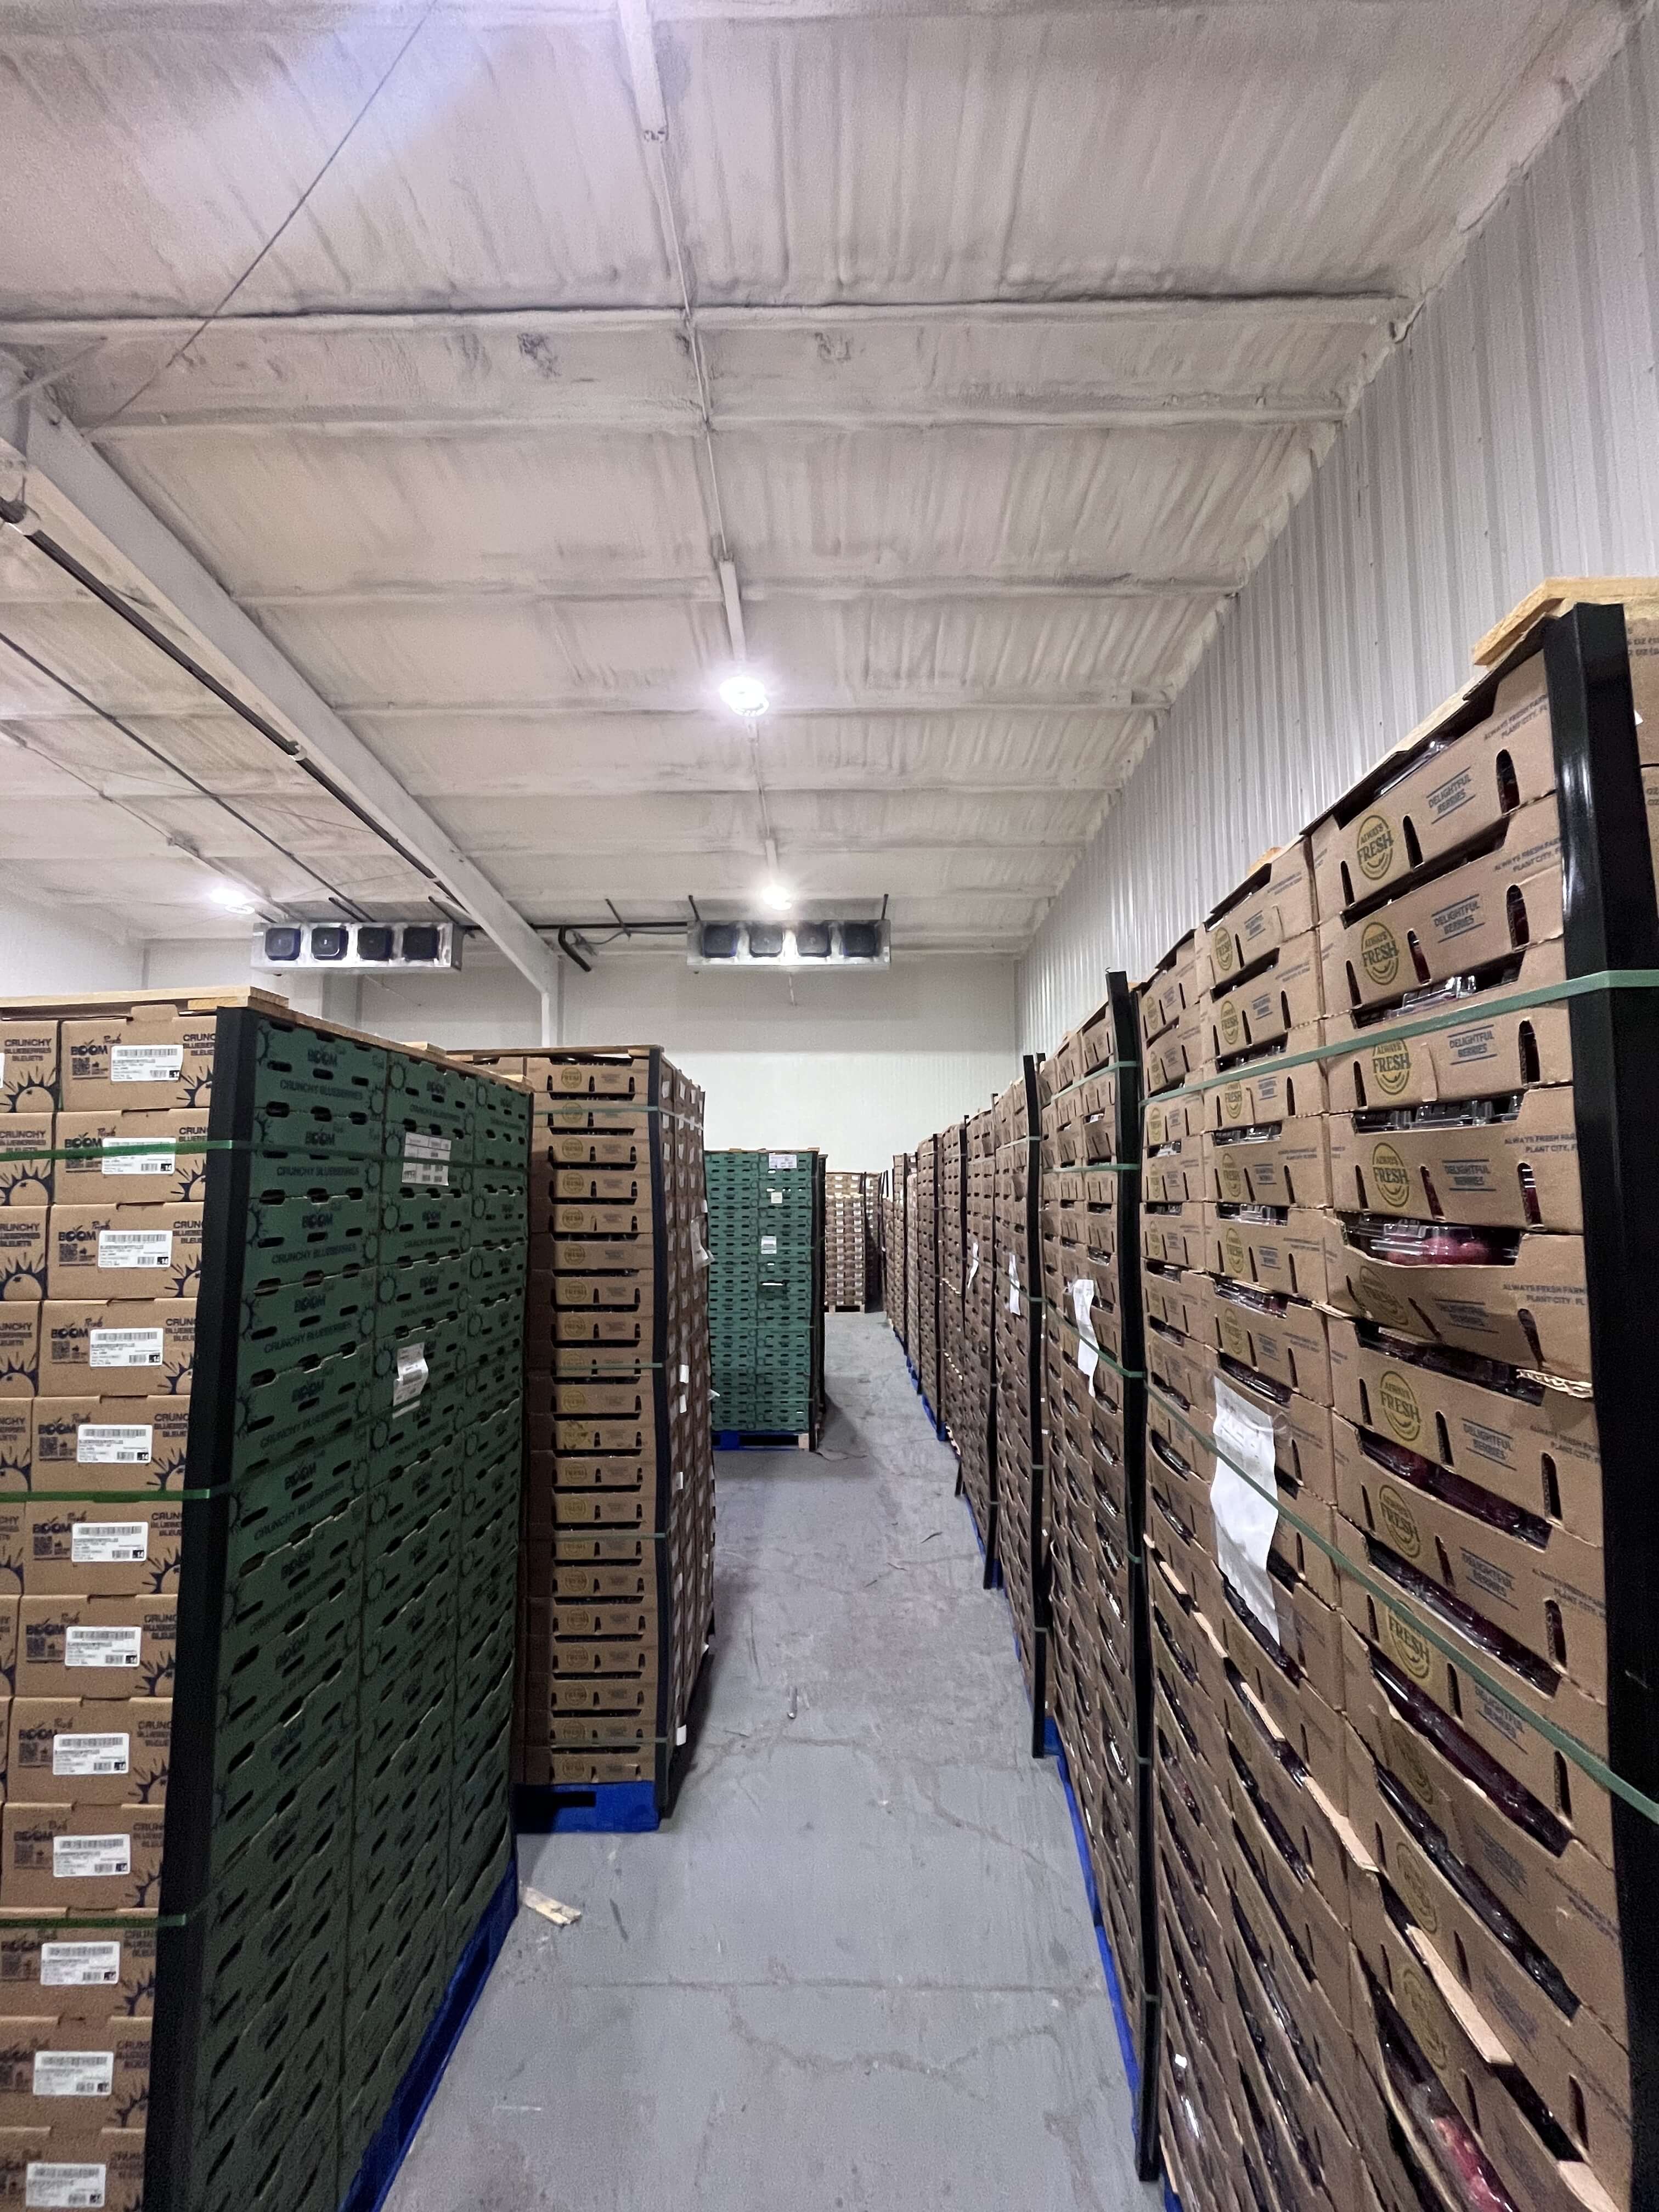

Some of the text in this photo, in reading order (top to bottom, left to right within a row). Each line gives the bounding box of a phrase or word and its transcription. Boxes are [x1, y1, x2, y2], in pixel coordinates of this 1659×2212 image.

[1428, 773, 1472, 809] DELIGHTFUL
[1437, 788, 1466, 815] BERRIES
[1361, 823, 1384, 844] ALWAYS
[1357, 831, 1394, 861] FRESH
[1513, 857, 1535, 871] PLANT
[1434, 901, 1480, 927] DELIGHTFUL
[1443, 915, 1474, 935] BERRIES
[1364, 931, 1388, 947] ALWAYS
[1362, 940, 1399, 967] FRESH
[5, 1039, 52, 1047] CRUNCHY
[1449, 1031, 1495, 1049] DELIGHTFUL
[71, 1045, 108, 1056] BOOM
[1375, 1041, 1402, 1057] ALWAYS
[1458, 1043, 1488, 1058] BERRIES
[1373, 1052, 1411, 1074] FRESH
[280, 1079, 318, 1093] CRUNCHY
[65, 1139, 103, 1148] BOOM
[305, 1131, 335, 1146] BOOM
[1505, 1136, 1534, 1144] ALWAYS
[1525, 1145, 1549, 1153] PLANT
[277, 1167, 313, 1176] CRUNCHY
[1373, 1167, 1409, 1185] FRESH
[1444, 1164, 1491, 1175] DELIGHTFUL
[302, 1213, 333, 1228] BOOM
[59, 1231, 96, 1242] BOOM
[272, 1249, 311, 1265] CRUNCHY
[1526, 1294, 1552, 1302] PLANT
[52, 1328, 89, 1339] BOOM
[264, 1333, 305, 1353] CRUNCHY
[1384, 1380, 1410, 1400] ALWAYS
[1380, 1390, 1421, 1423] FRESH
[1463, 1423, 1513, 1451] DELIGHTFUL
[1472, 1438, 1506, 1460] BERRIES
[33, 1523, 72, 1534] BOOM
[1381, 1502, 1420, 1543] FRESH
[1390, 1614, 1427, 1661] FRESH
